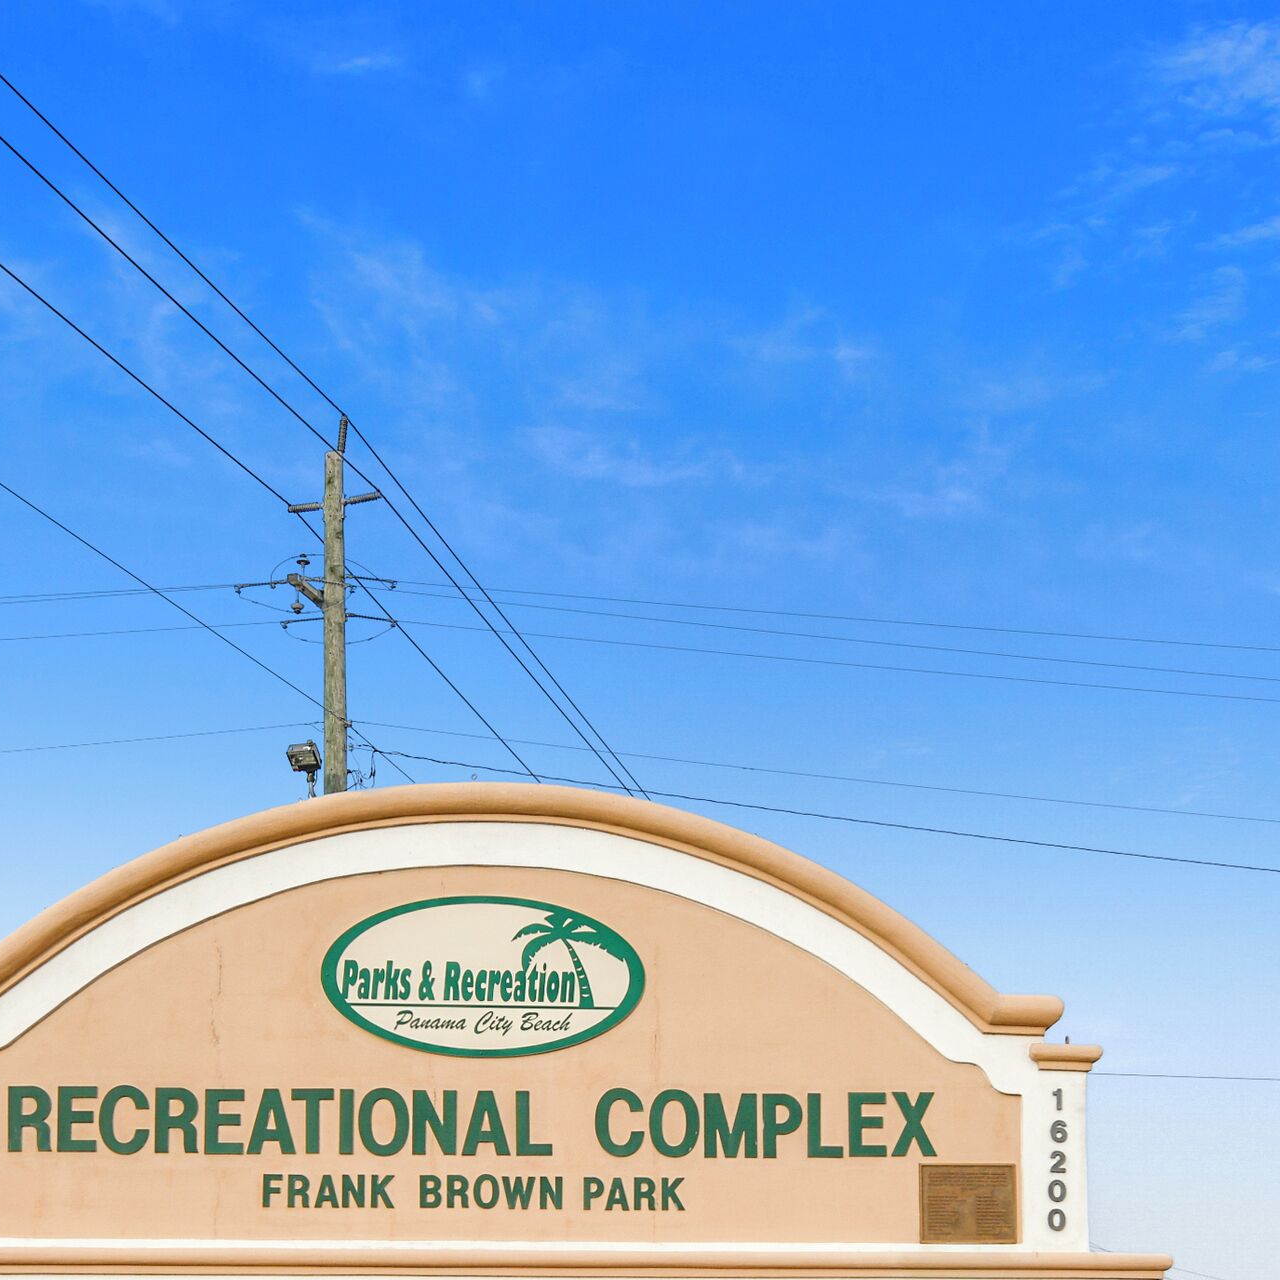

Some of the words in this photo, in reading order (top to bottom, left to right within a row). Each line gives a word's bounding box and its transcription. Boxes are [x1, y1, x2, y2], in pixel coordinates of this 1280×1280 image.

[342, 959, 411, 1000] Parks
[419, 960, 435, 1000] &
[444, 961, 576, 1003] Recreation
[394, 1010, 466, 1032] Panama
[474, 1010, 513, 1036] City
[519, 1011, 571, 1032] Beach
[7, 1085, 553, 1157] RECREATIONAL
[595, 1087, 938, 1159] COMPLEX
[262, 1173, 395, 1209] FRANK
[419, 1173, 563, 1210] BROWN
[583, 1176, 686, 1211] PARK
